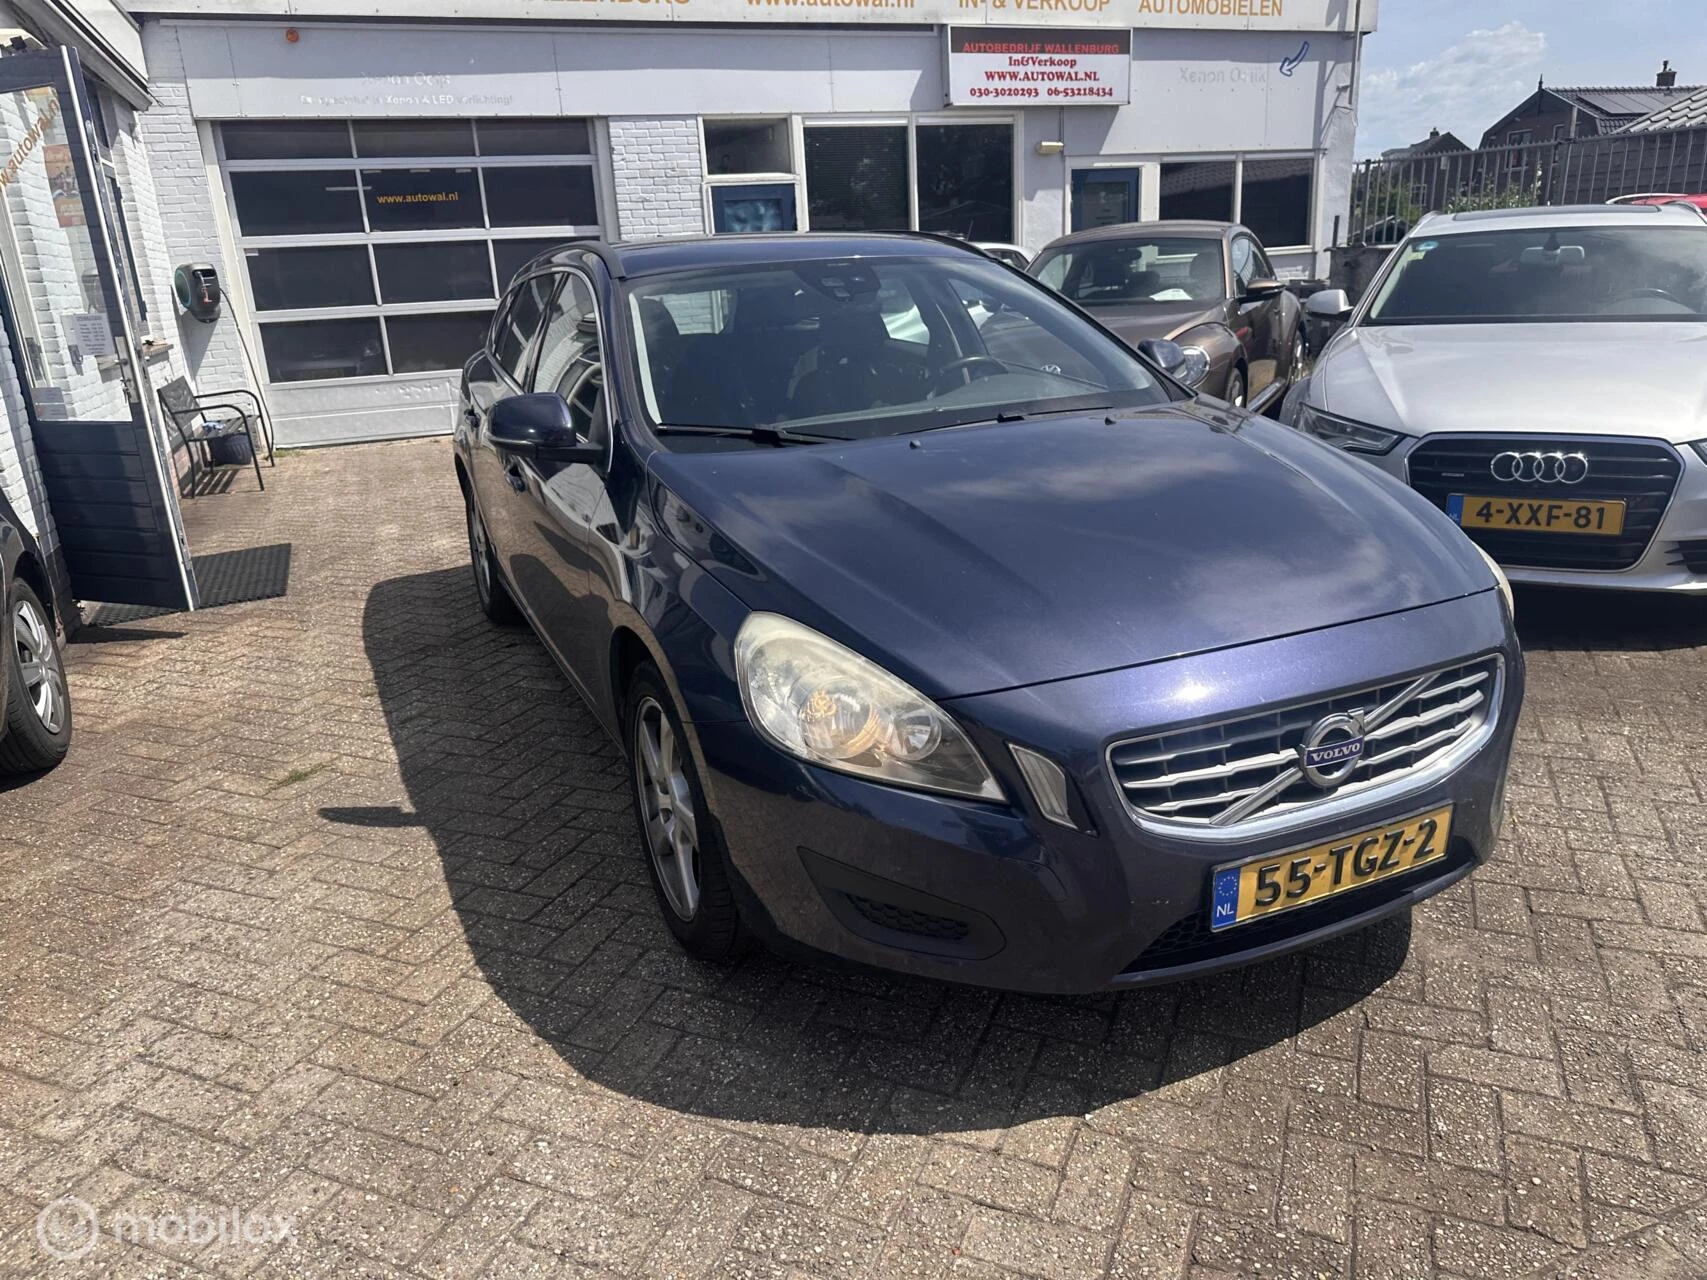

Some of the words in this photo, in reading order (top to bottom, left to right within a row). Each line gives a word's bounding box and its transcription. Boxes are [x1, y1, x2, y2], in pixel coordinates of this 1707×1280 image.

[1138, 0, 1283, 17] AUTOMOBIELEN
[963, 42, 1041, 53] AUTOBEDRIJF
[1044, 43, 1120, 54] WALLENBURG
[1008, 56, 1077, 68] In&Verkoop
[984, 71, 1100, 82] WWW.AUTOWAL.NL
[970, 86, 1039, 97] 030-3020293
[1047, 86, 1113, 98] 06-53218434
[432, 94, 454, 104] LED
[376, 191, 459, 204] www.autowal.nl
[1475, 501, 1606, 530] 4-XXF-81
[1309, 741, 1361, 763] VOLVO
[1254, 818, 1438, 907] 55-TGZ-2
[1216, 902, 1235, 918] NL
